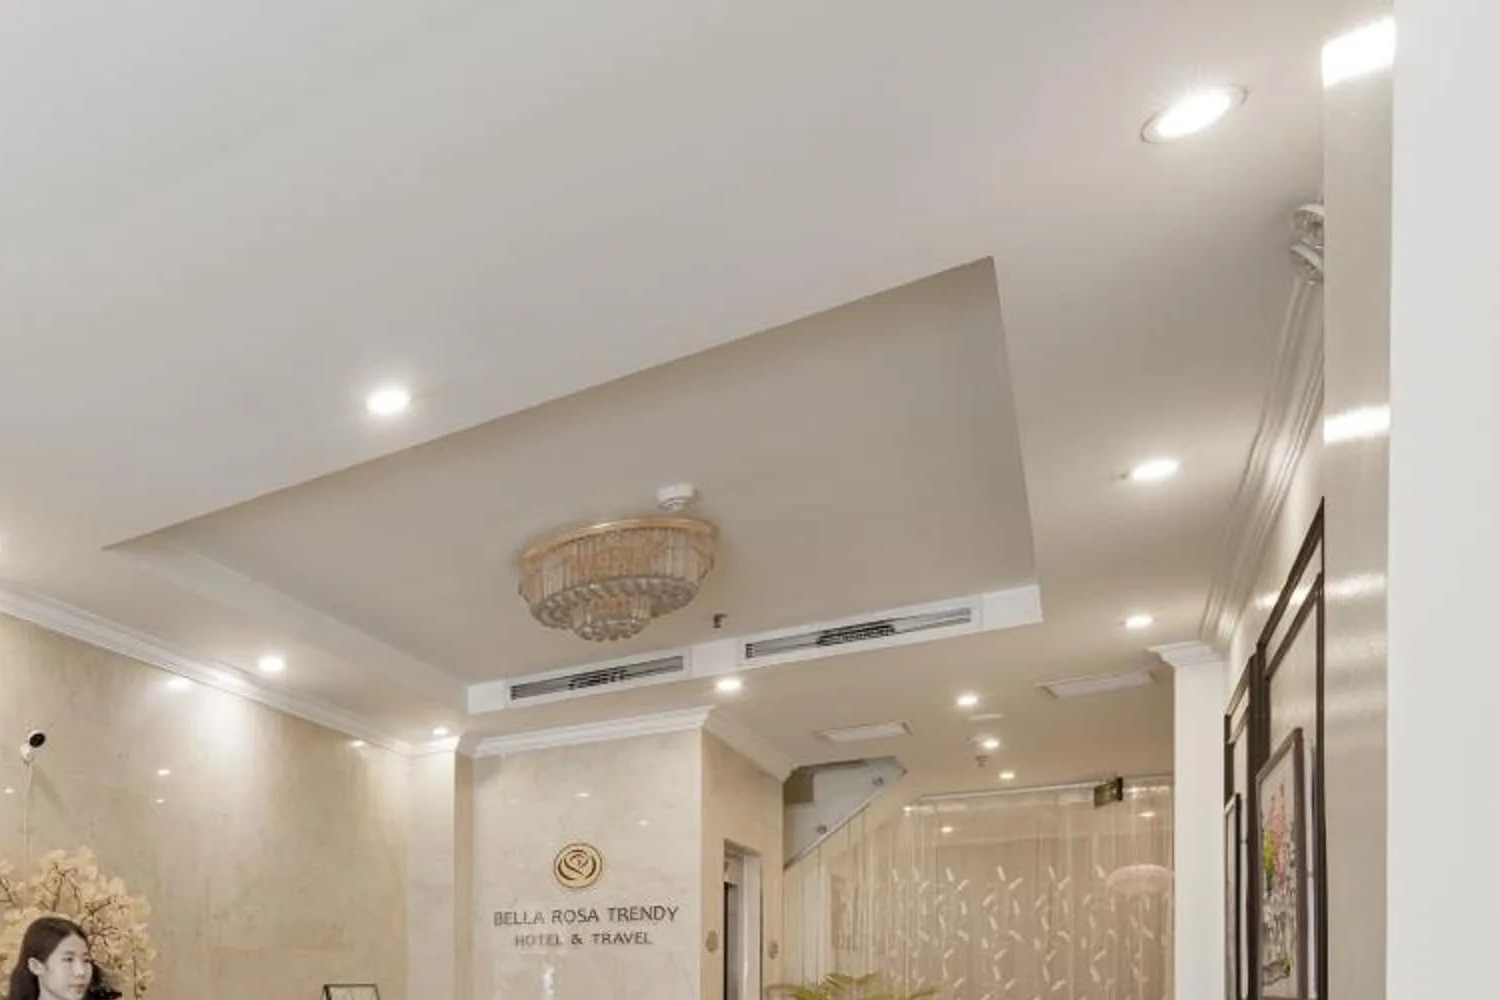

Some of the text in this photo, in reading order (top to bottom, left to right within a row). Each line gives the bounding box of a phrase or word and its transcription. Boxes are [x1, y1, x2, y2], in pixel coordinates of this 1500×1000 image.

[493, 905, 679, 926] BELLA ROSA TRENDY
[515, 932, 652, 948] HOTEL & TRAVEL
